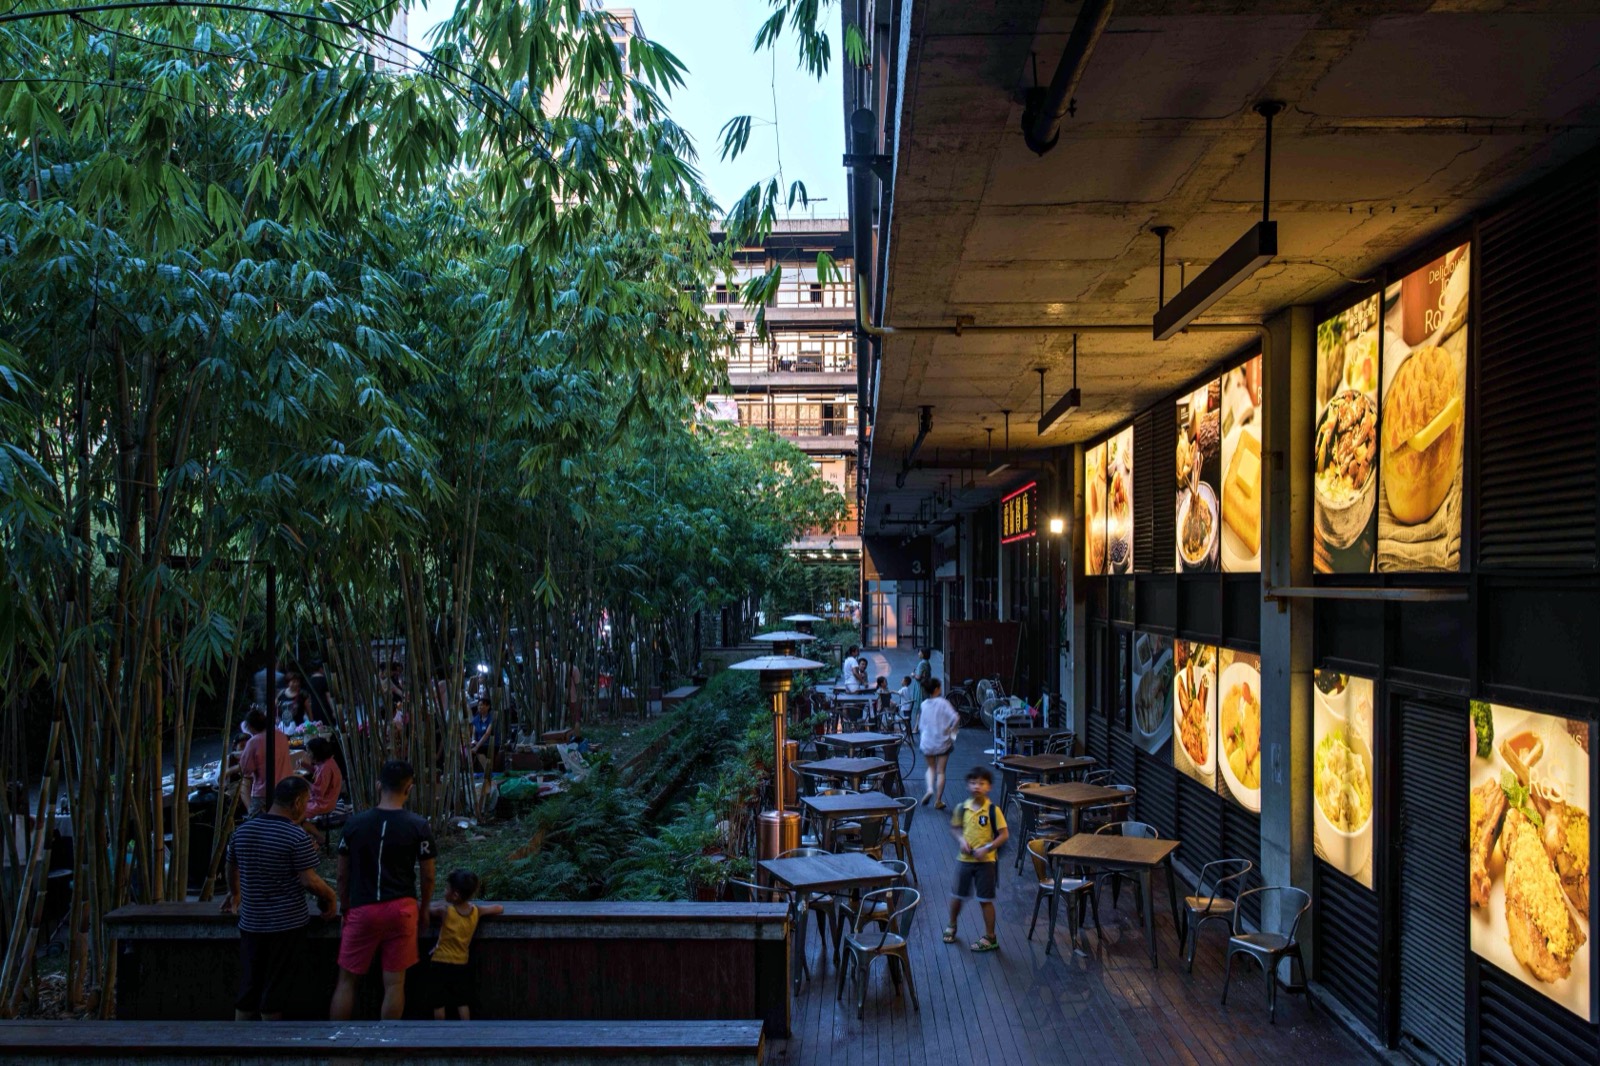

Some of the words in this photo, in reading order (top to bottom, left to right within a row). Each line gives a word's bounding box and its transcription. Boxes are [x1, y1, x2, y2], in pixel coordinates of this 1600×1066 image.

[1428, 255, 1465, 285] Delicious
[911, 559, 922, 575] 3
[419, 840, 431, 855] R
